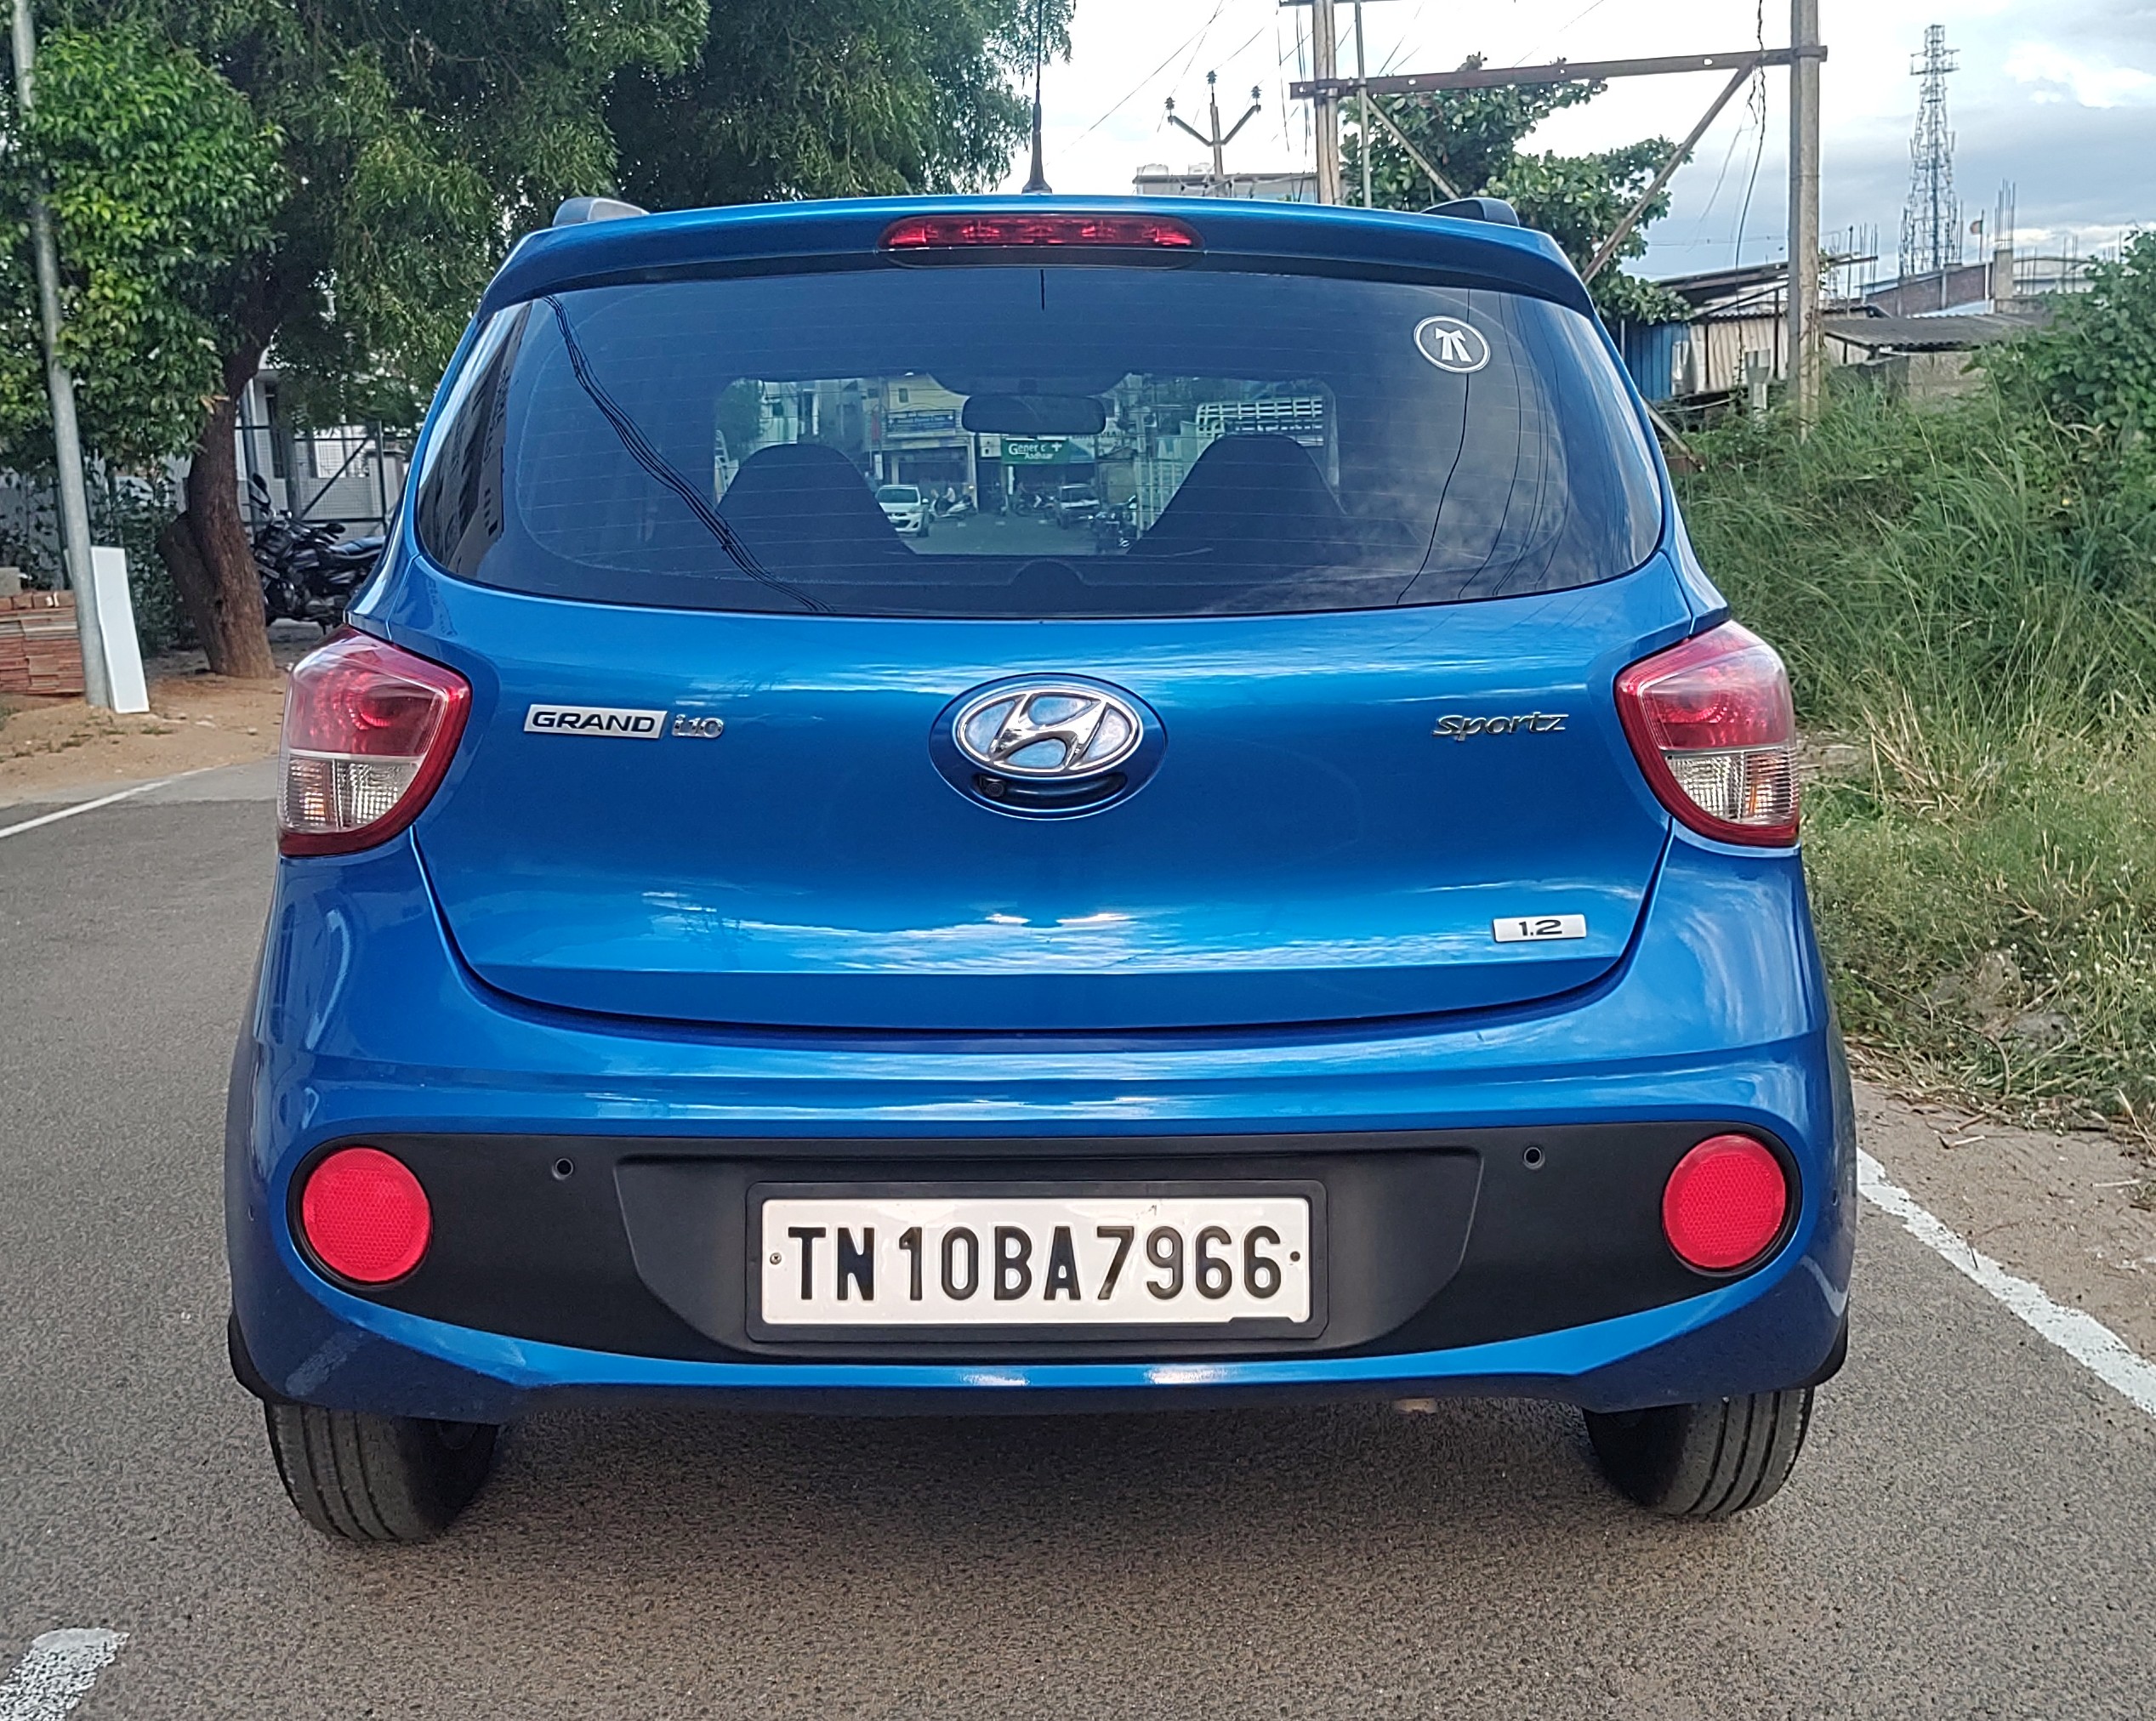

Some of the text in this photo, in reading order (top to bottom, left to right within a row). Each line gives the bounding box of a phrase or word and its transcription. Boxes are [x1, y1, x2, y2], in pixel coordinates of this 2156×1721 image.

[1008, 442, 1046, 456] Generc
[532, 711, 724, 738] GRAND i10
[1518, 919, 1562, 936] 1.2
